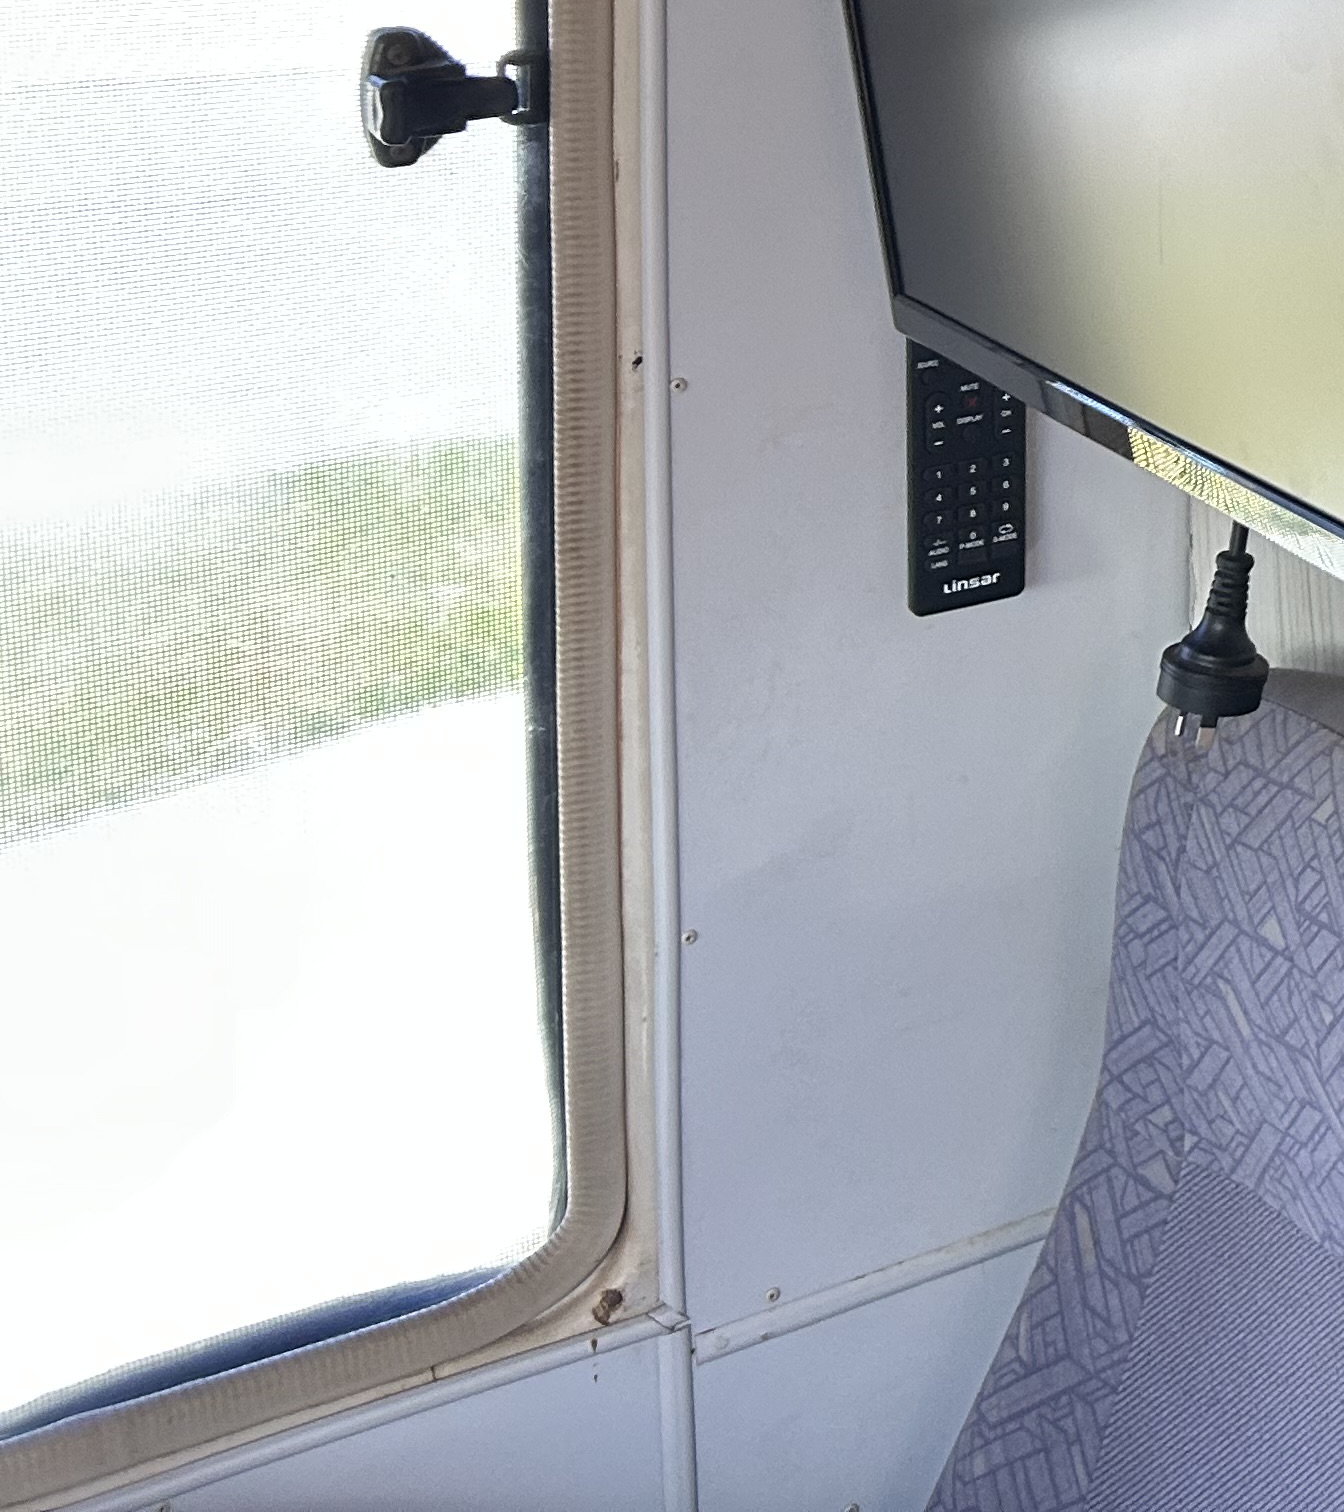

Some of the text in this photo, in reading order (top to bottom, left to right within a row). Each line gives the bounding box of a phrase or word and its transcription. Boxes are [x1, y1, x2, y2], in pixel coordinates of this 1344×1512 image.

[956, 413, 984, 425] DISPLAY
[968, 464, 977, 473] 2
[1002, 457, 1010, 467] 3
[935, 479, 1010, 502] 4 5 6
[969, 508, 977, 518] 8
[1002, 501, 1010, 511] 9
